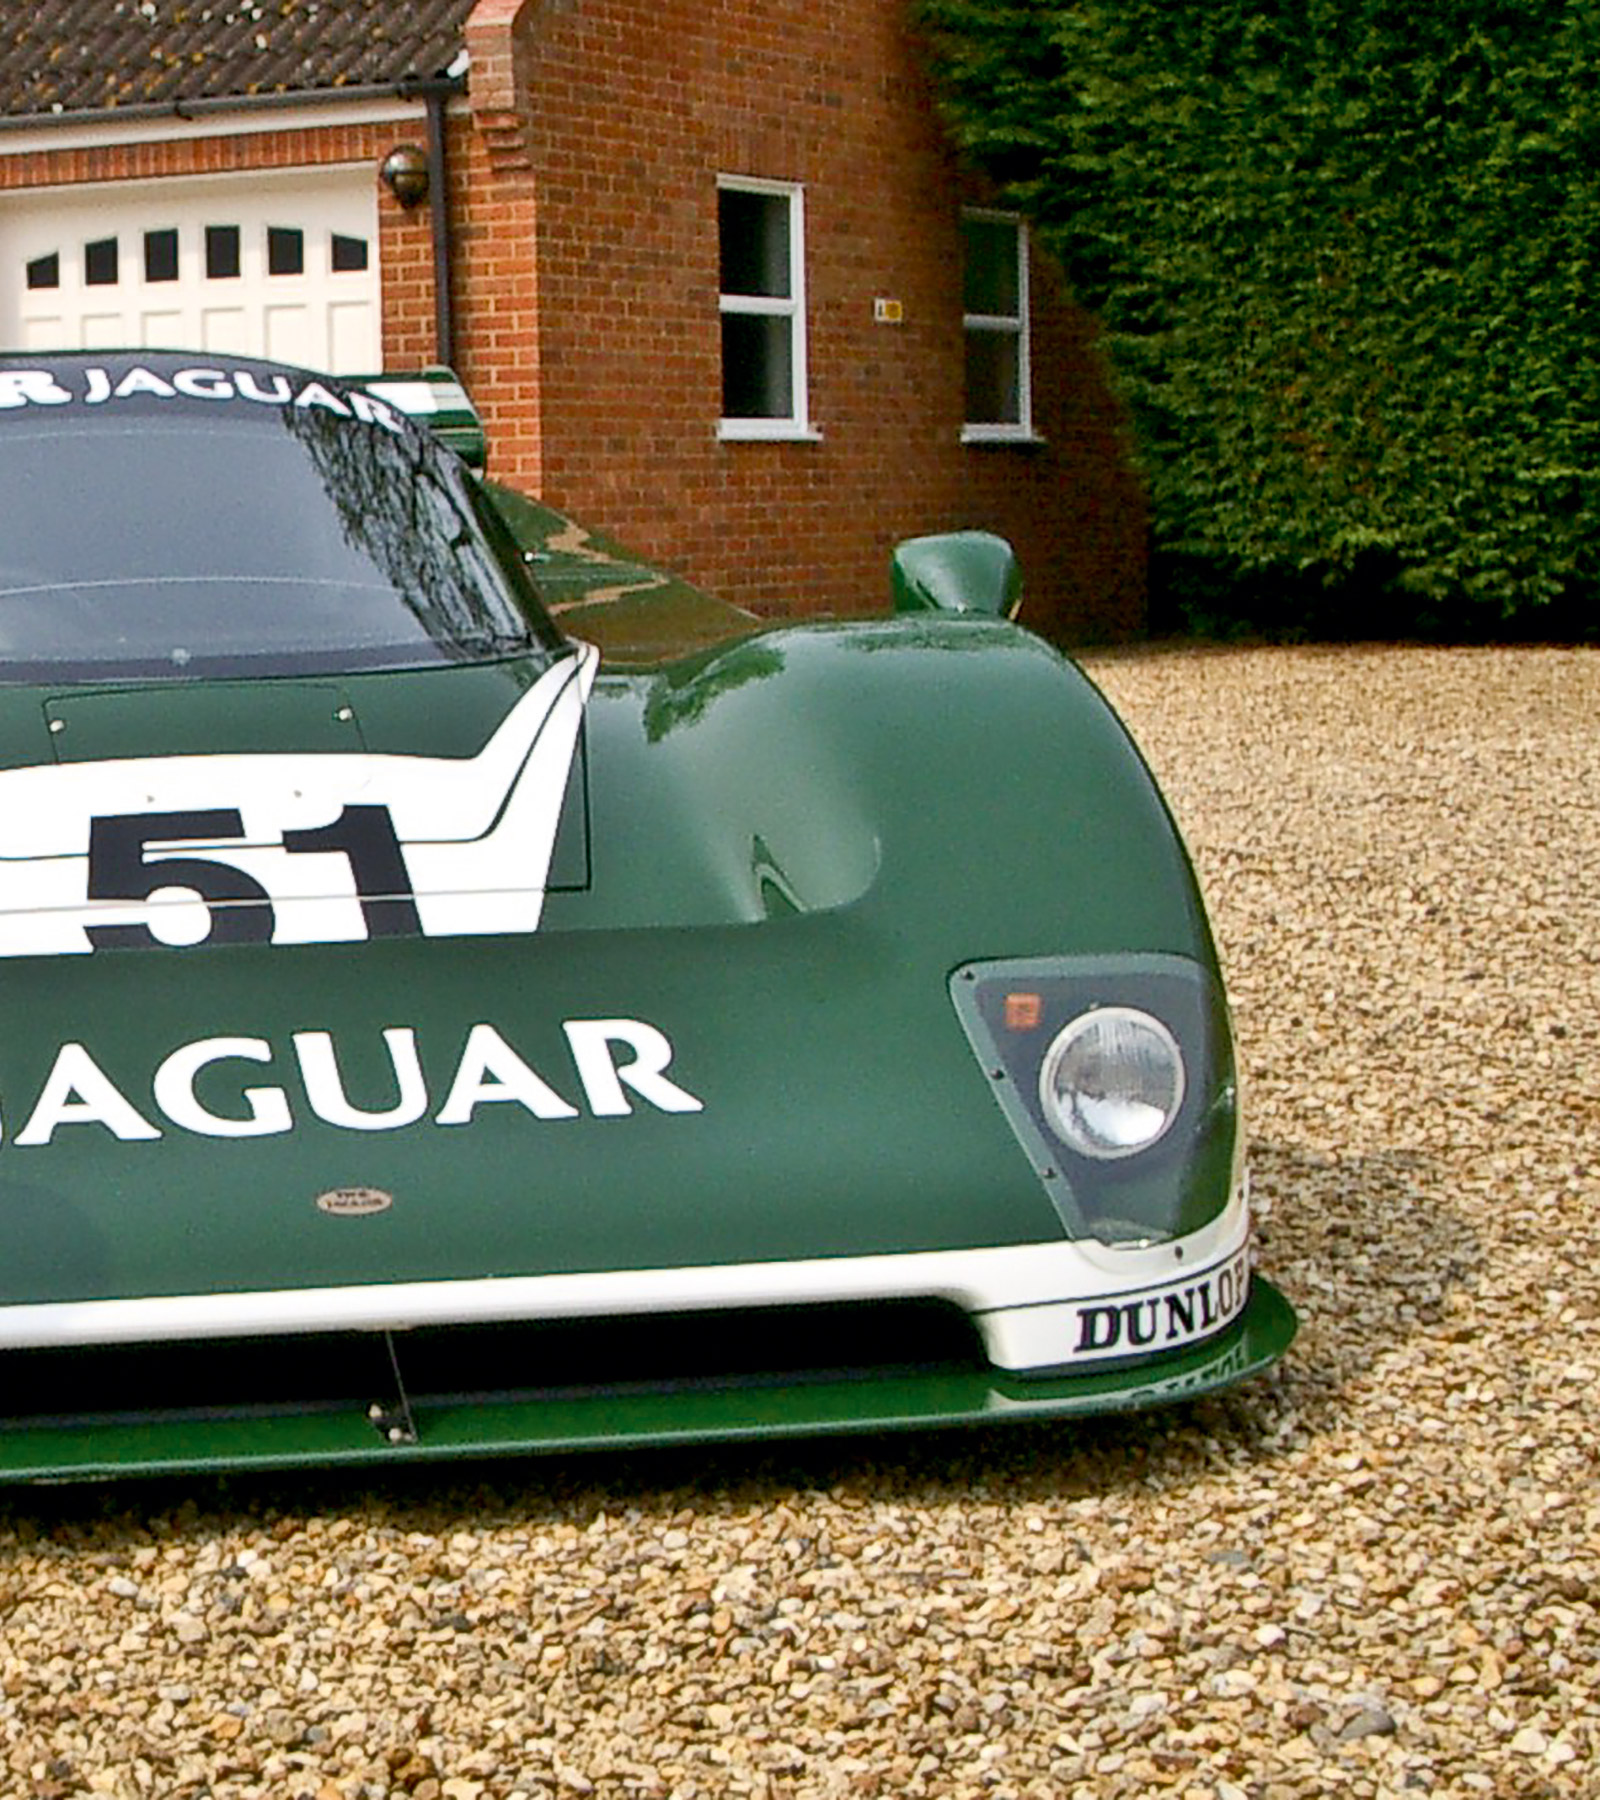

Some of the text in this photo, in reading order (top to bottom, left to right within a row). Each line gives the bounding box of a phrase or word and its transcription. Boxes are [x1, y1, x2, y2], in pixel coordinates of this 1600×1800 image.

[84, 367, 404, 433] JAGUAR
[82, 804, 425, 953] 51
[1072, 1257, 1244, 1353] DUNLOP
